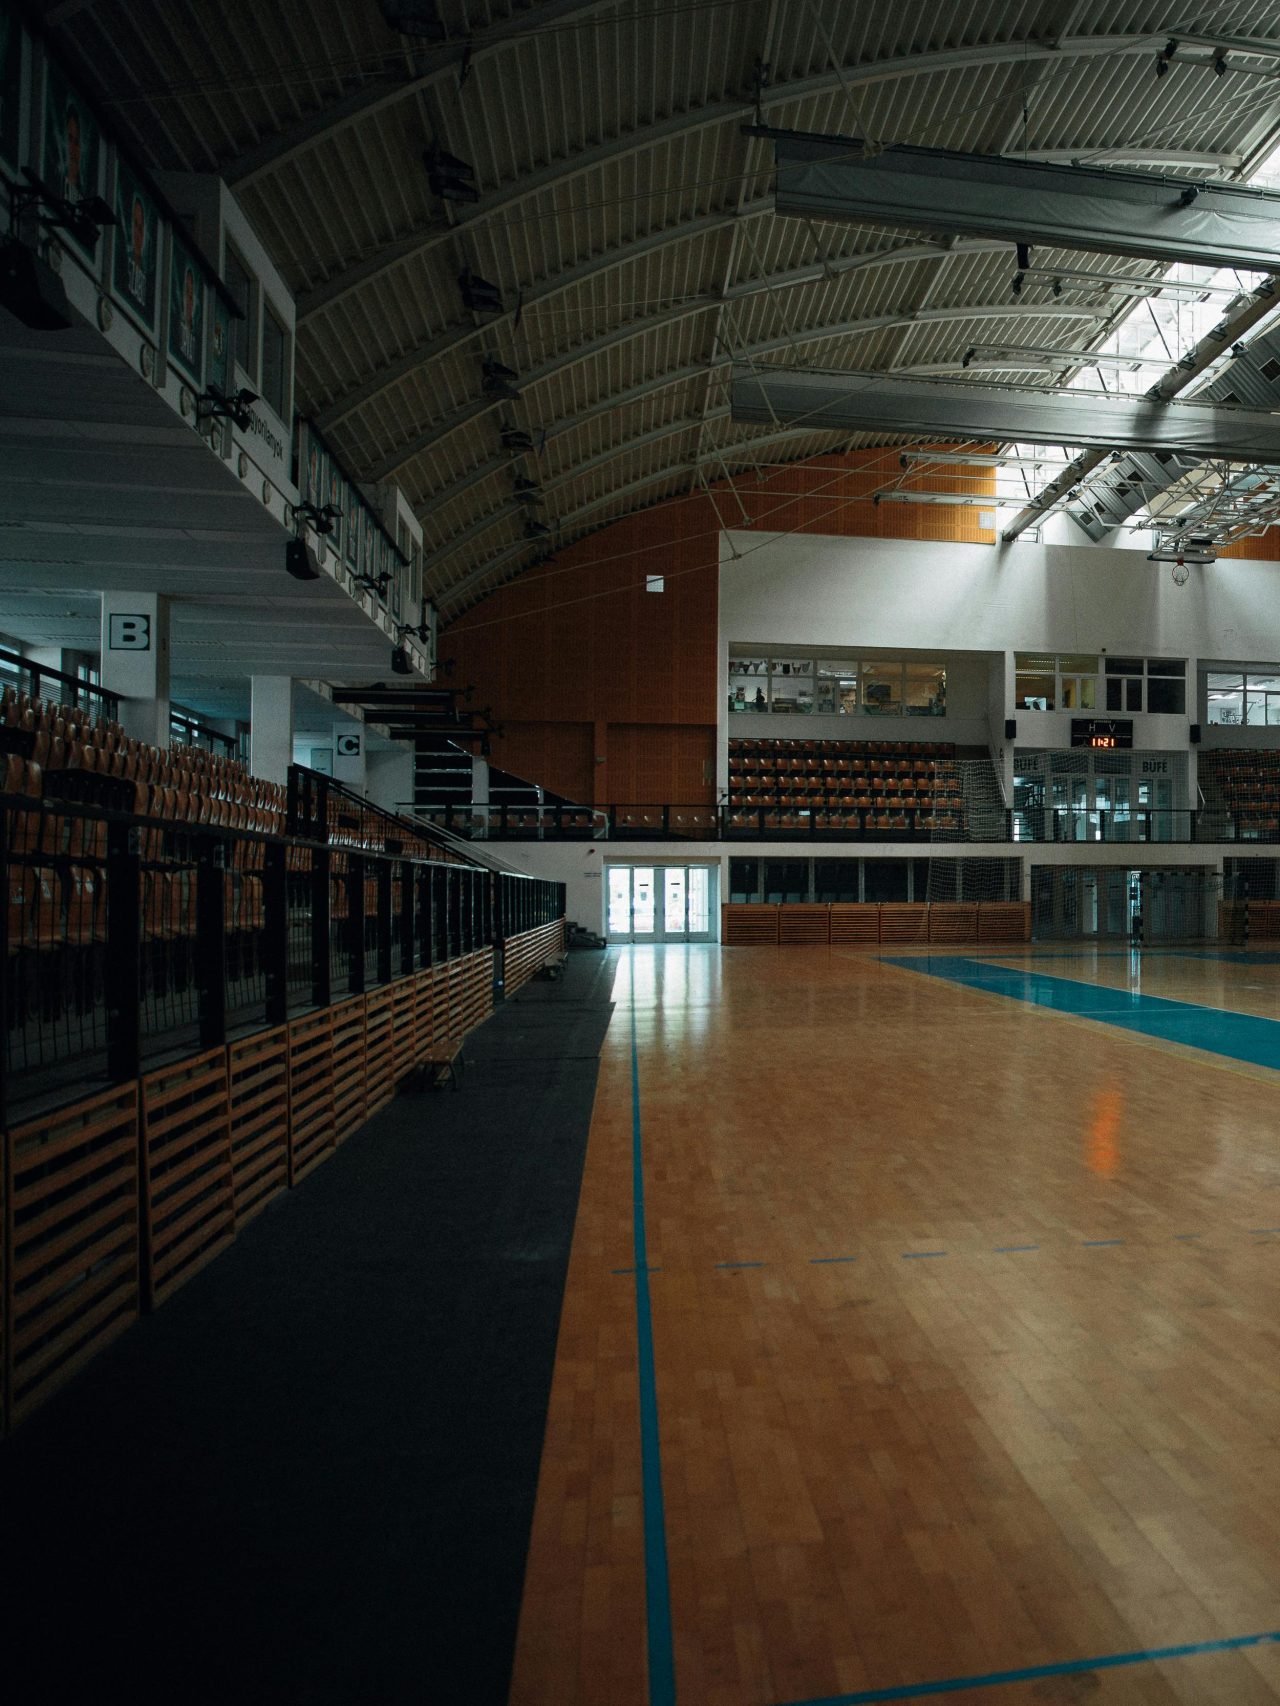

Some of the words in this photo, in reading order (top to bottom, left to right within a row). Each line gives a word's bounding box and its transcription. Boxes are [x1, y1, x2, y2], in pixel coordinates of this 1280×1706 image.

[109, 614, 149, 650] B
[1088, 723, 1096, 732] H
[1108, 723, 1116, 733] V
[337, 735, 359, 755] C
[1142, 758, 1168, 773] BÜFÉ
